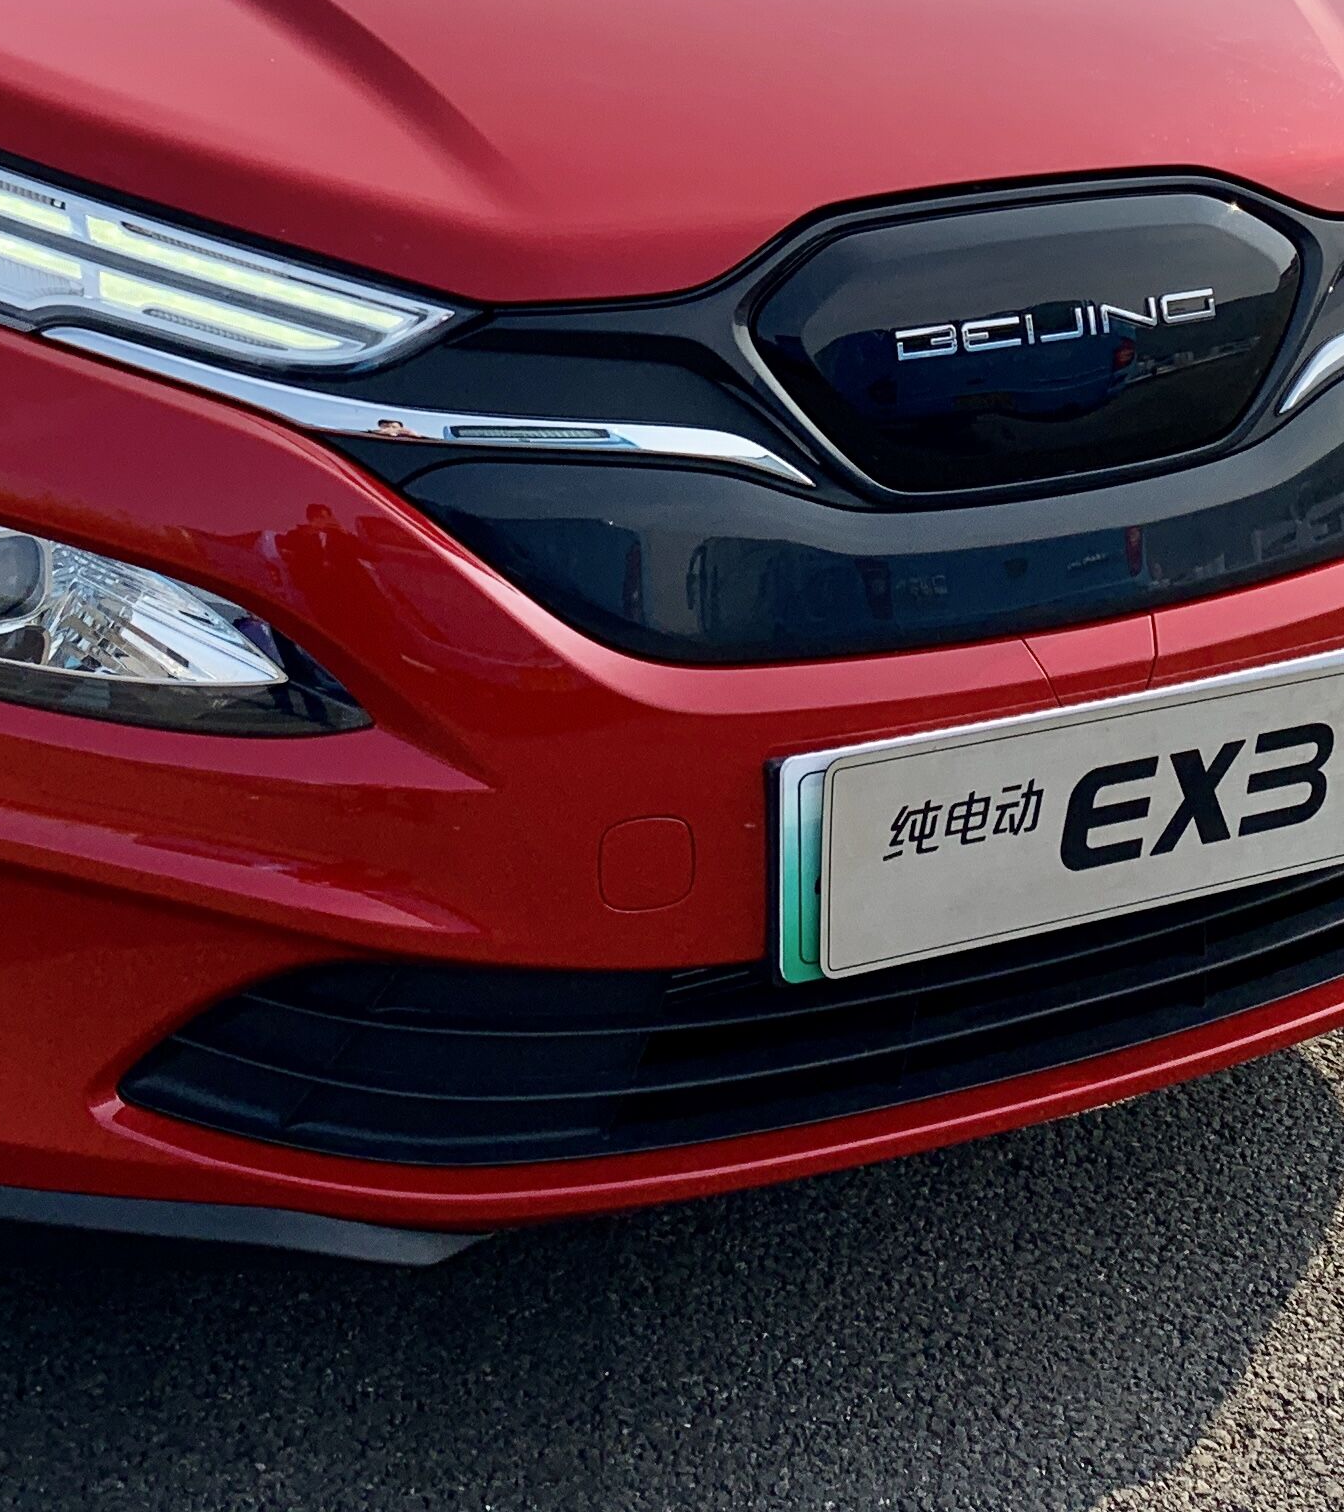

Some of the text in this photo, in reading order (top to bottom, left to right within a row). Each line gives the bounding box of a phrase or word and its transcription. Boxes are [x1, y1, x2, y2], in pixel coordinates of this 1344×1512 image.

[895, 287, 1215, 362] BEIJING
[882, 722, 1335, 872] 纯电动 EX3
